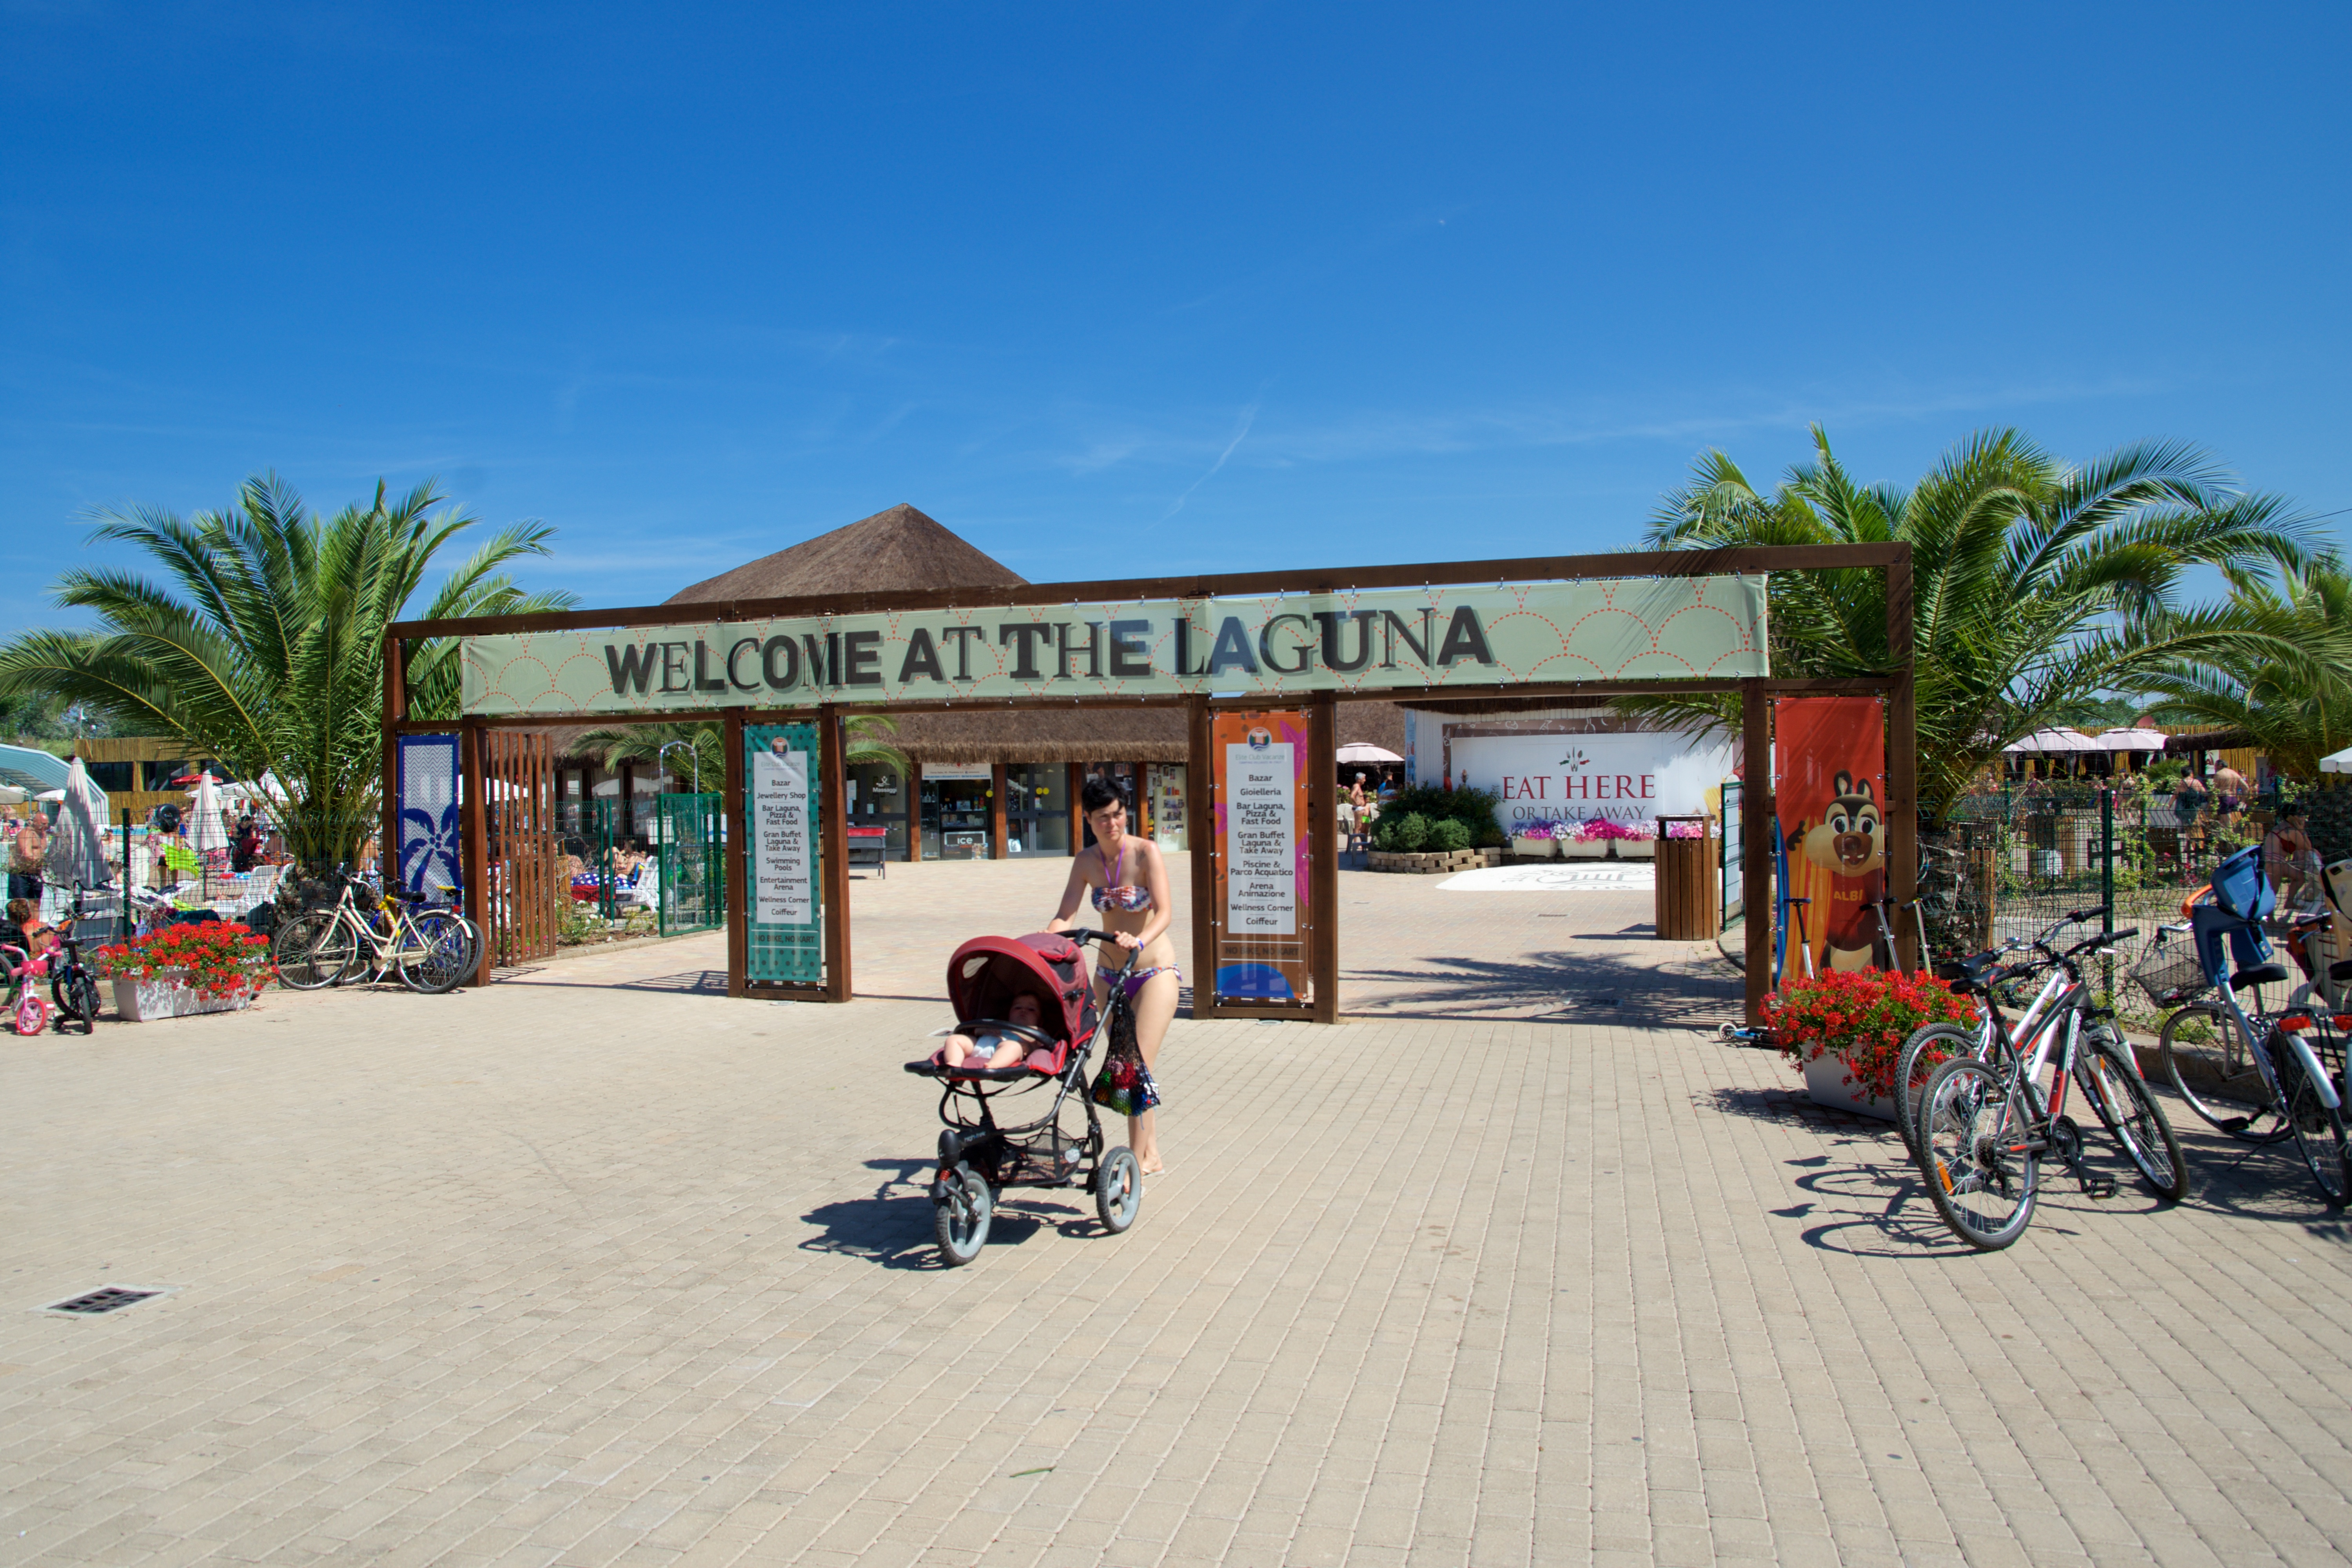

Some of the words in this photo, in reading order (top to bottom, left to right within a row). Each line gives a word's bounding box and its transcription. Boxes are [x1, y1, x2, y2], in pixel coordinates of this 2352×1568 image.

[604, 629, 884, 695] WELCOME
[897, 625, 982, 684] AT
[999, 619, 1153, 681] THE
[1172, 604, 1497, 677] LAGUNA
[1502, 776, 1551, 799] EAT
[1564, 775, 1655, 799] HERE
[1513, 806, 1536, 820] OR
[1542, 806, 1586, 820] TAKE
[1593, 806, 1647, 819] AWAY
[957, 835, 973, 844] ice
[1255, 869, 1293, 877] Acquatico
[1833, 889, 1863, 902] ALBI
[2067, 1011, 2082, 1072] ROCKRIDER
